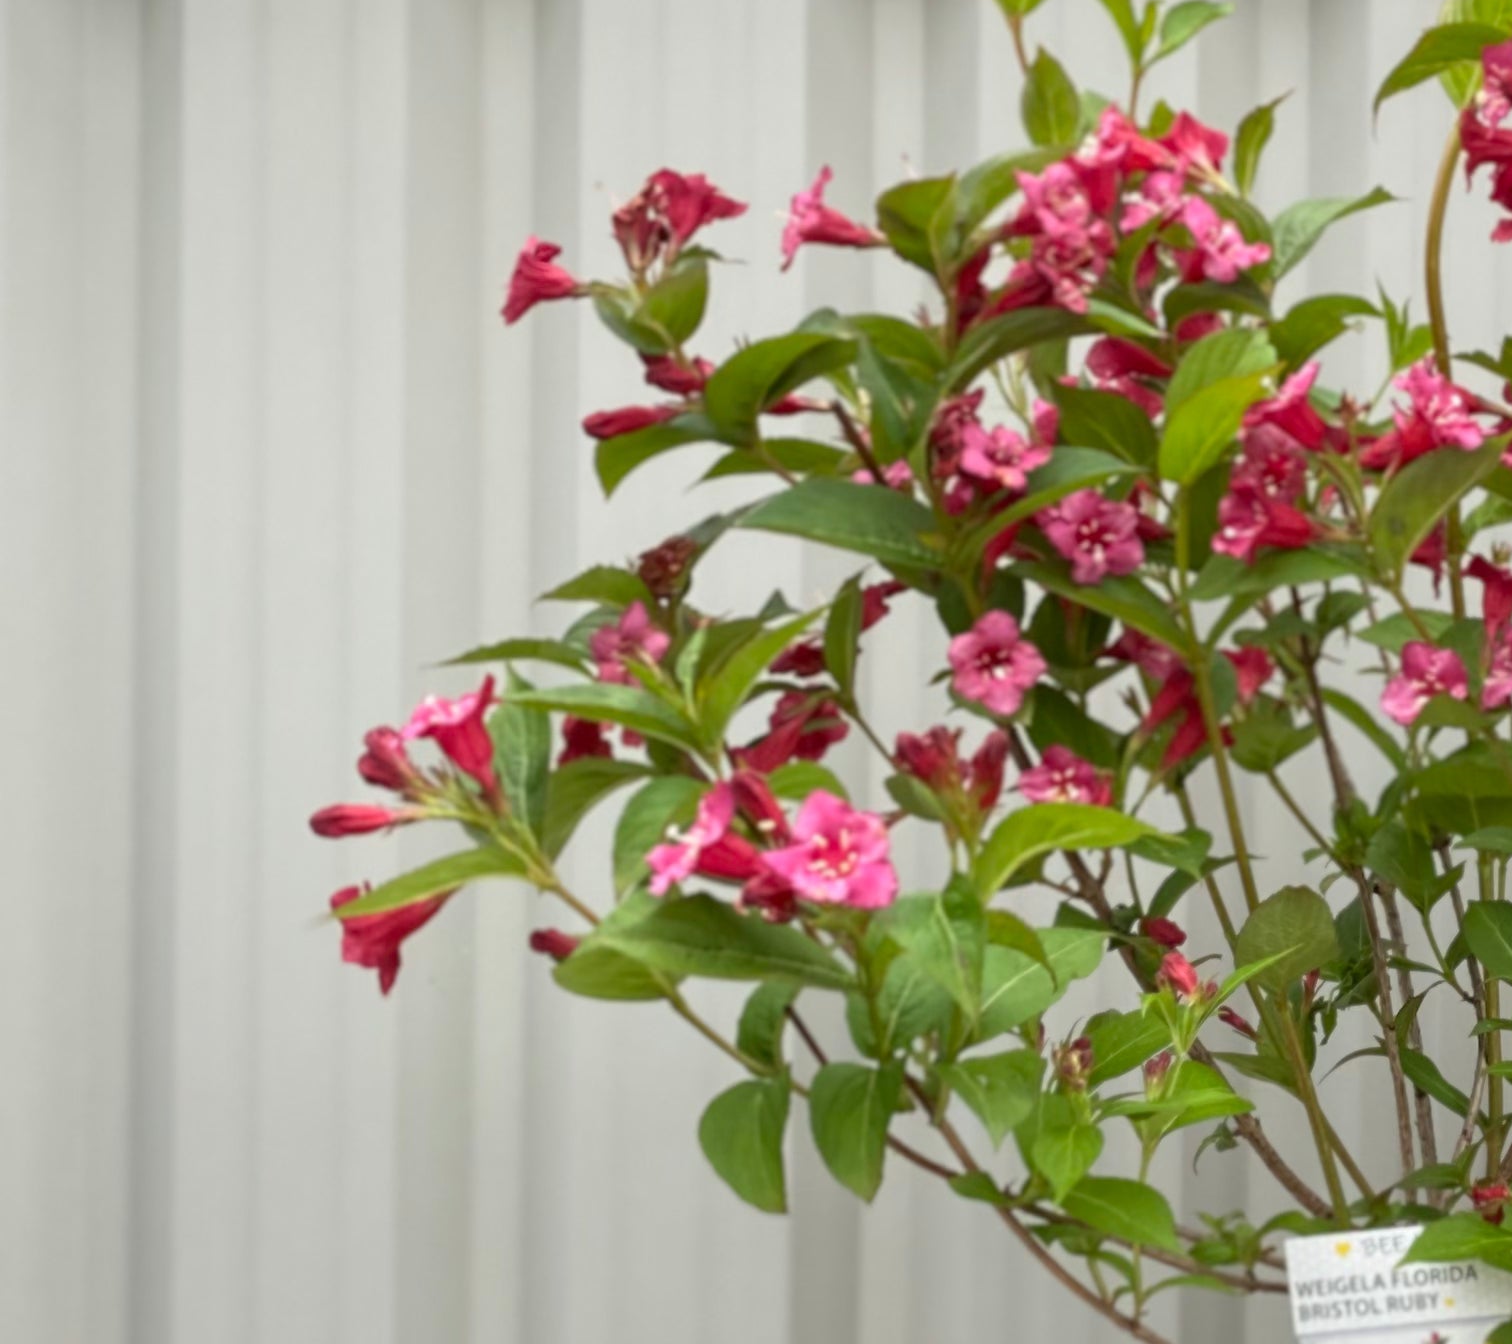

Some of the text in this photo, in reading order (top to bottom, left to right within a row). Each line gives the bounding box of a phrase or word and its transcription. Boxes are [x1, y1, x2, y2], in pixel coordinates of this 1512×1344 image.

[1297, 1265, 1478, 1297] WEIGELA FLORIDA
[1300, 1293, 1439, 1322] BRISTOL RUBY
